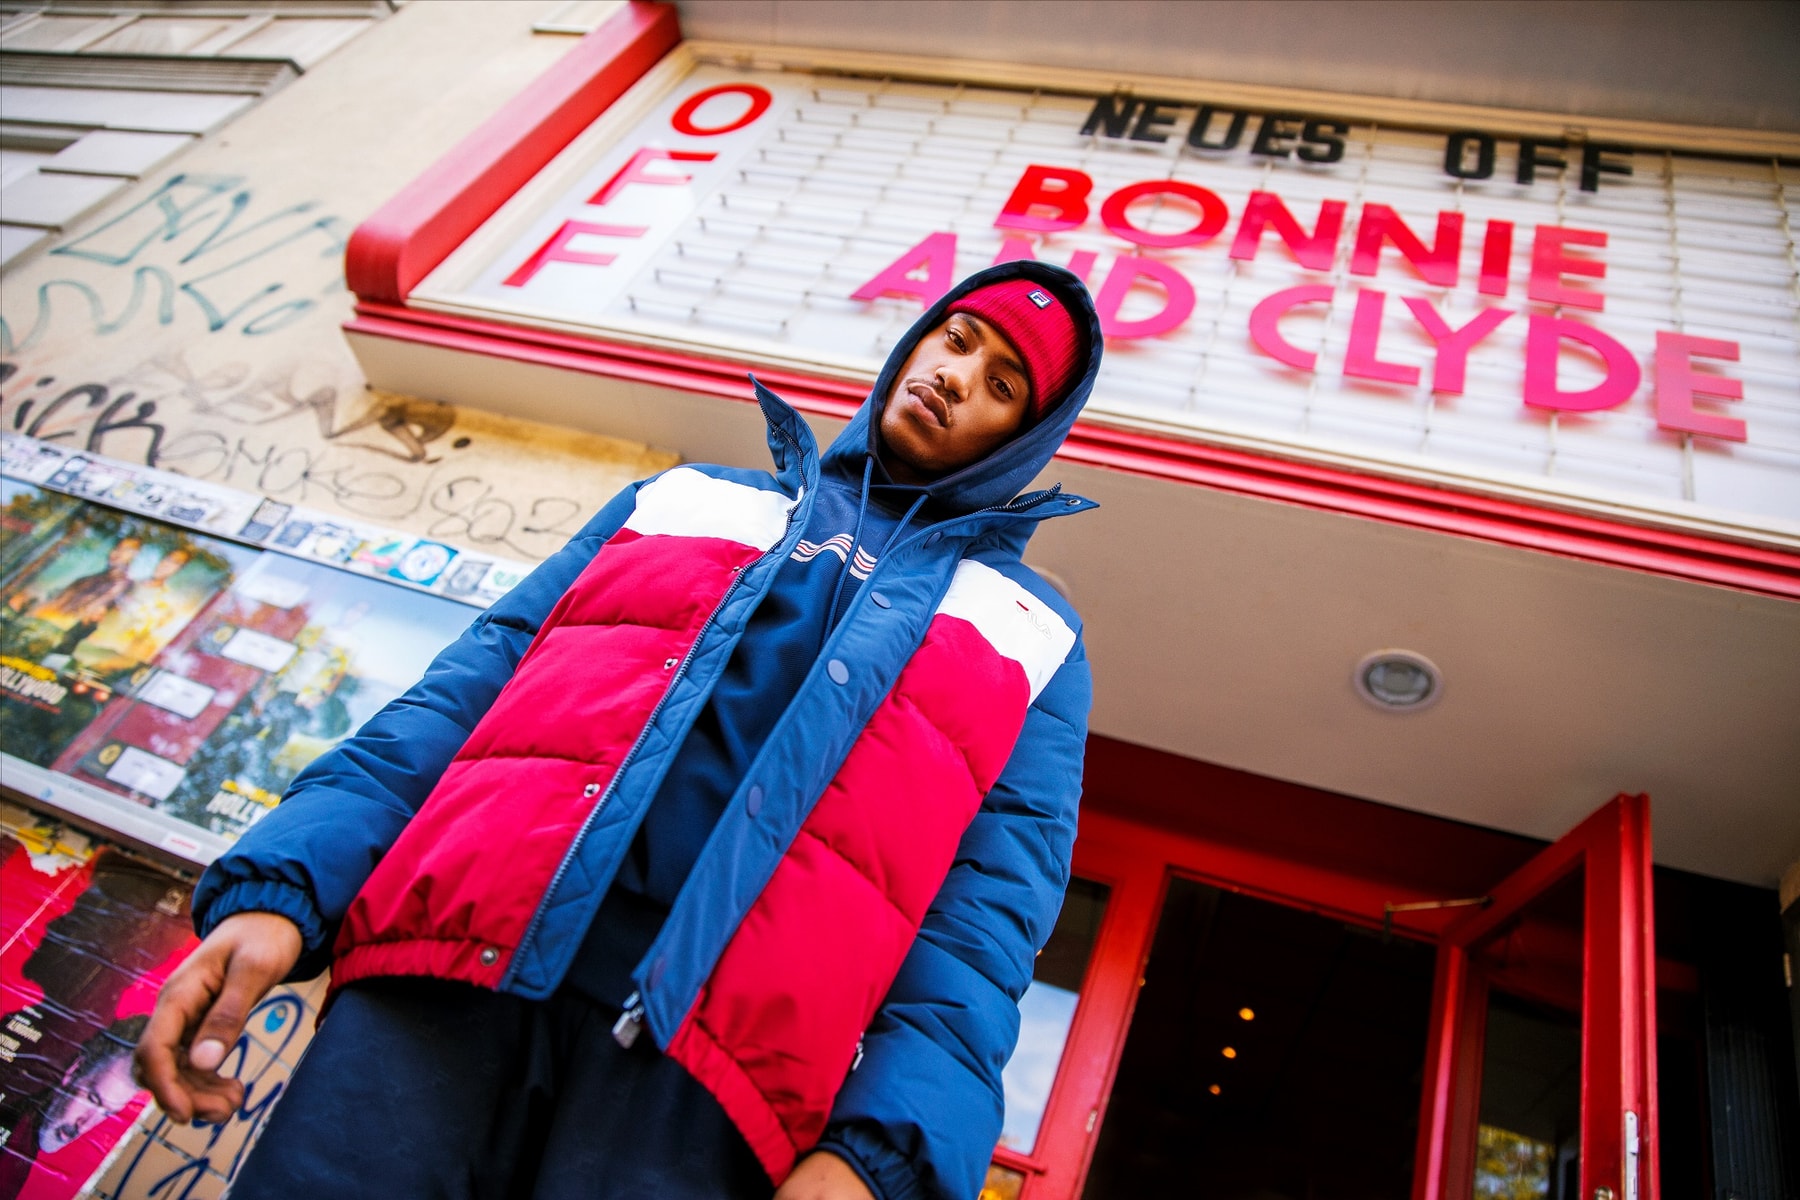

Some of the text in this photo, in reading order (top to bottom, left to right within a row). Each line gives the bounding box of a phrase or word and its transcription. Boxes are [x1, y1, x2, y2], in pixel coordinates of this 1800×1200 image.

[502, 83, 773, 287] OFF
[1080, 94, 1633, 191] NEUES OFF
[994, 165, 1607, 311] BONNIE
[1248, 283, 1747, 443] CLYDE
